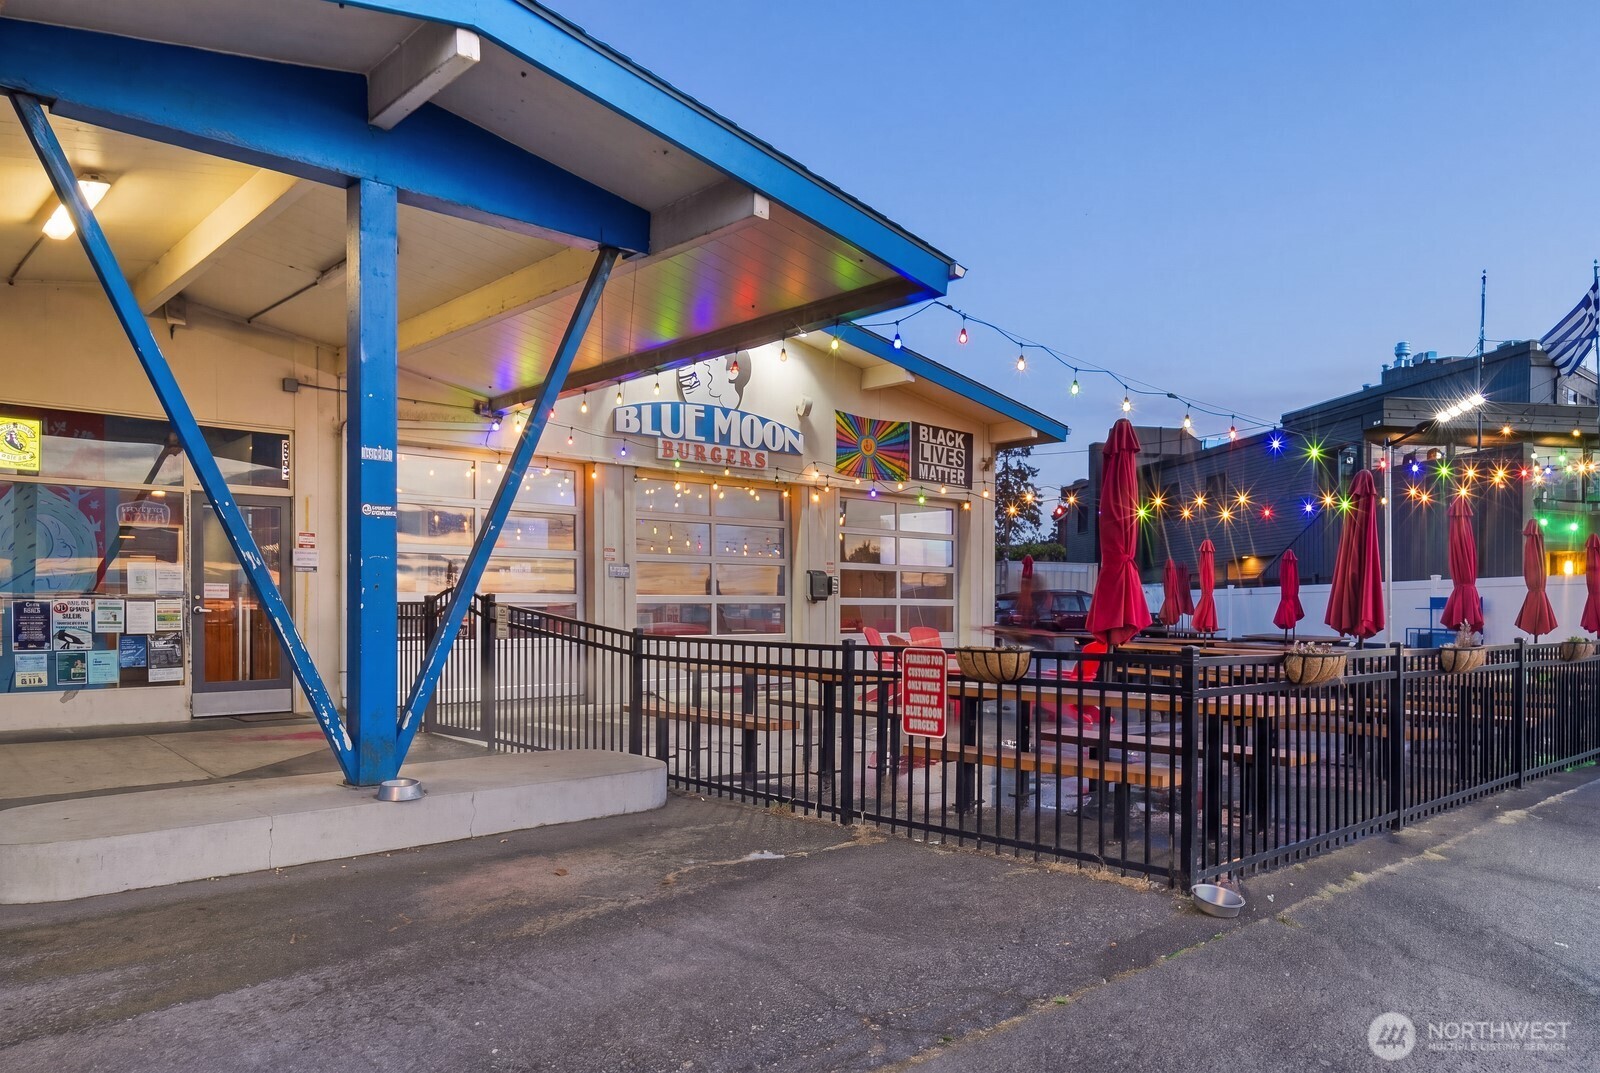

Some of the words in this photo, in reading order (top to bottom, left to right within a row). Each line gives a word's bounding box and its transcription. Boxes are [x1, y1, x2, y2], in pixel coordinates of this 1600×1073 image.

[615, 403, 706, 442] BLUE
[713, 407, 804, 455] MOON
[919, 425, 965, 449] BLACK
[661, 440, 767, 469] BURGERS
[920, 443, 965, 467] LIVES
[919, 463, 965, 485] MATTER
[906, 654, 930, 665] PARKING
[931, 655, 943, 666] FOR
[908, 668, 940, 679] CUSTOMERS
[908, 680, 921, 691] ONLY
[922, 681, 941, 692] WHILE
[910, 693, 929, 704] DINING
[930, 694, 938, 706] AT
[906, 705, 921, 717] BLUE
[922, 706, 942, 719] MOON
[910, 719, 938, 732] BURGERS
